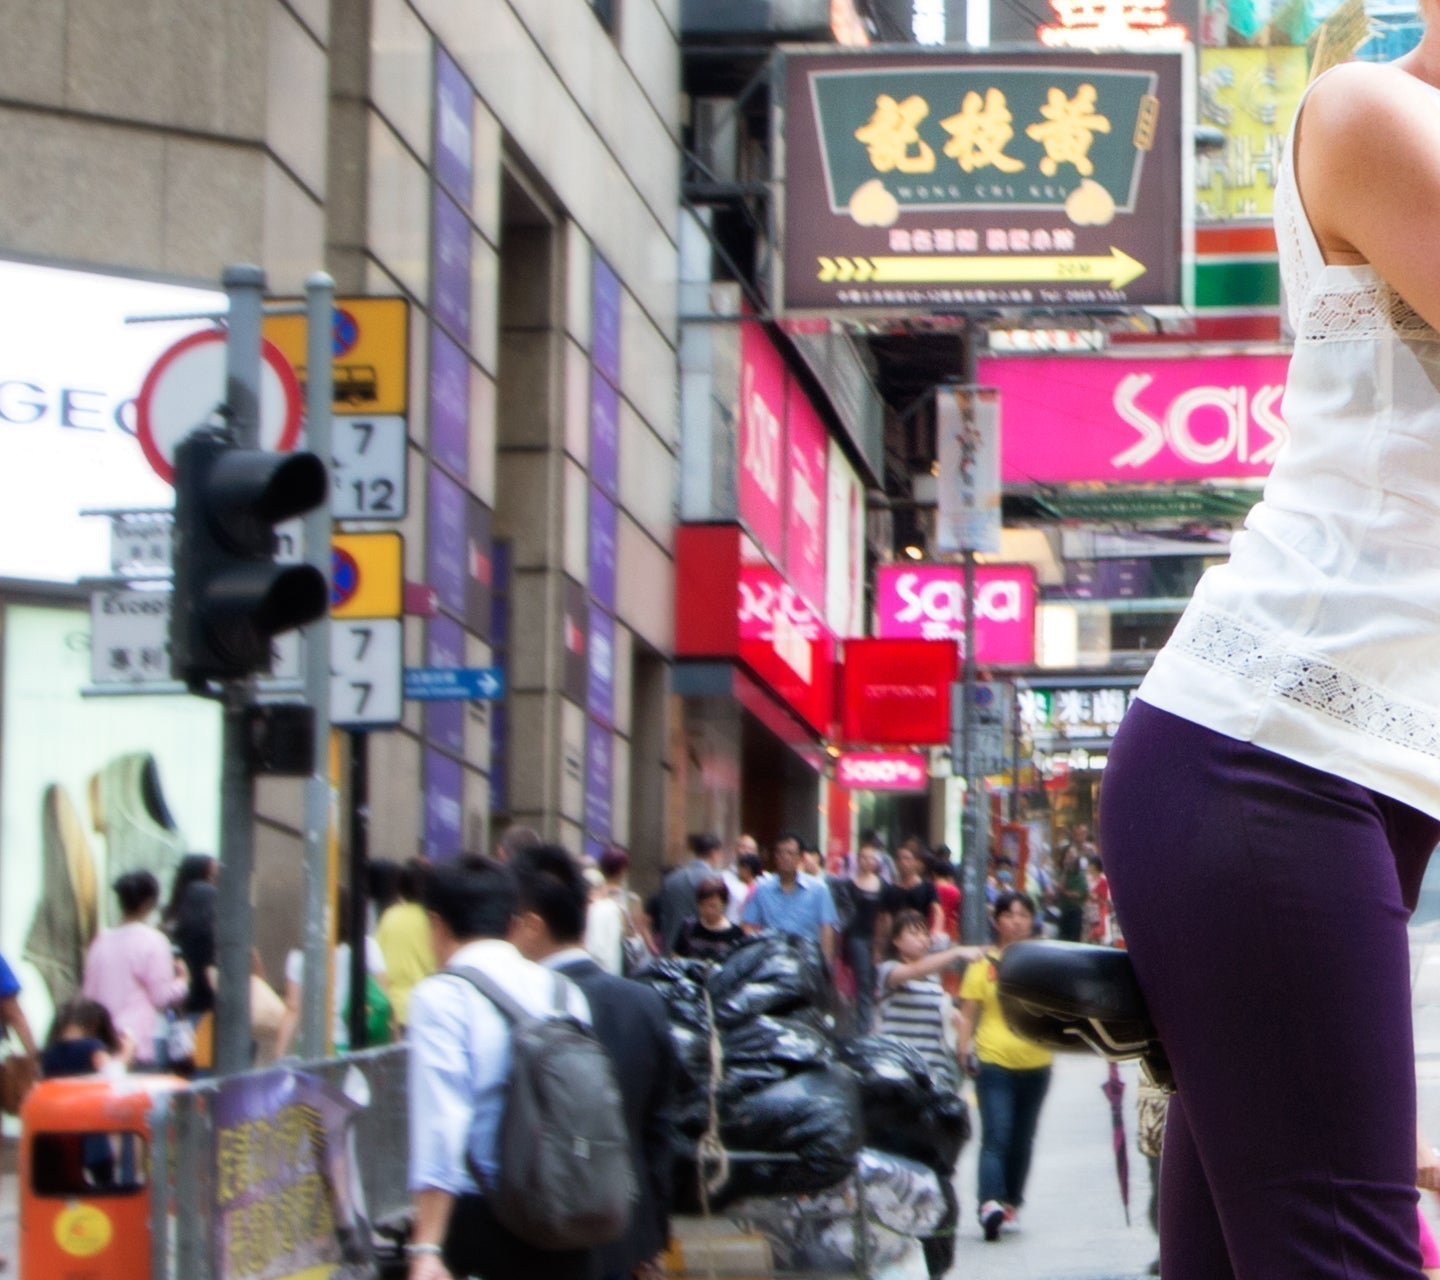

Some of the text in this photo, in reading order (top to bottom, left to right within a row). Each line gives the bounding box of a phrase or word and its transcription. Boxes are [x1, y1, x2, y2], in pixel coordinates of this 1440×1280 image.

[897, 183, 961, 199] WONG
[975, 183, 1015, 198] CHI
[351, 423, 375, 455] 7
[351, 477, 394, 511] 12
[894, 573, 1021, 622] Saa
[350, 627, 373, 661] 7
[350, 682, 373, 716] 7
